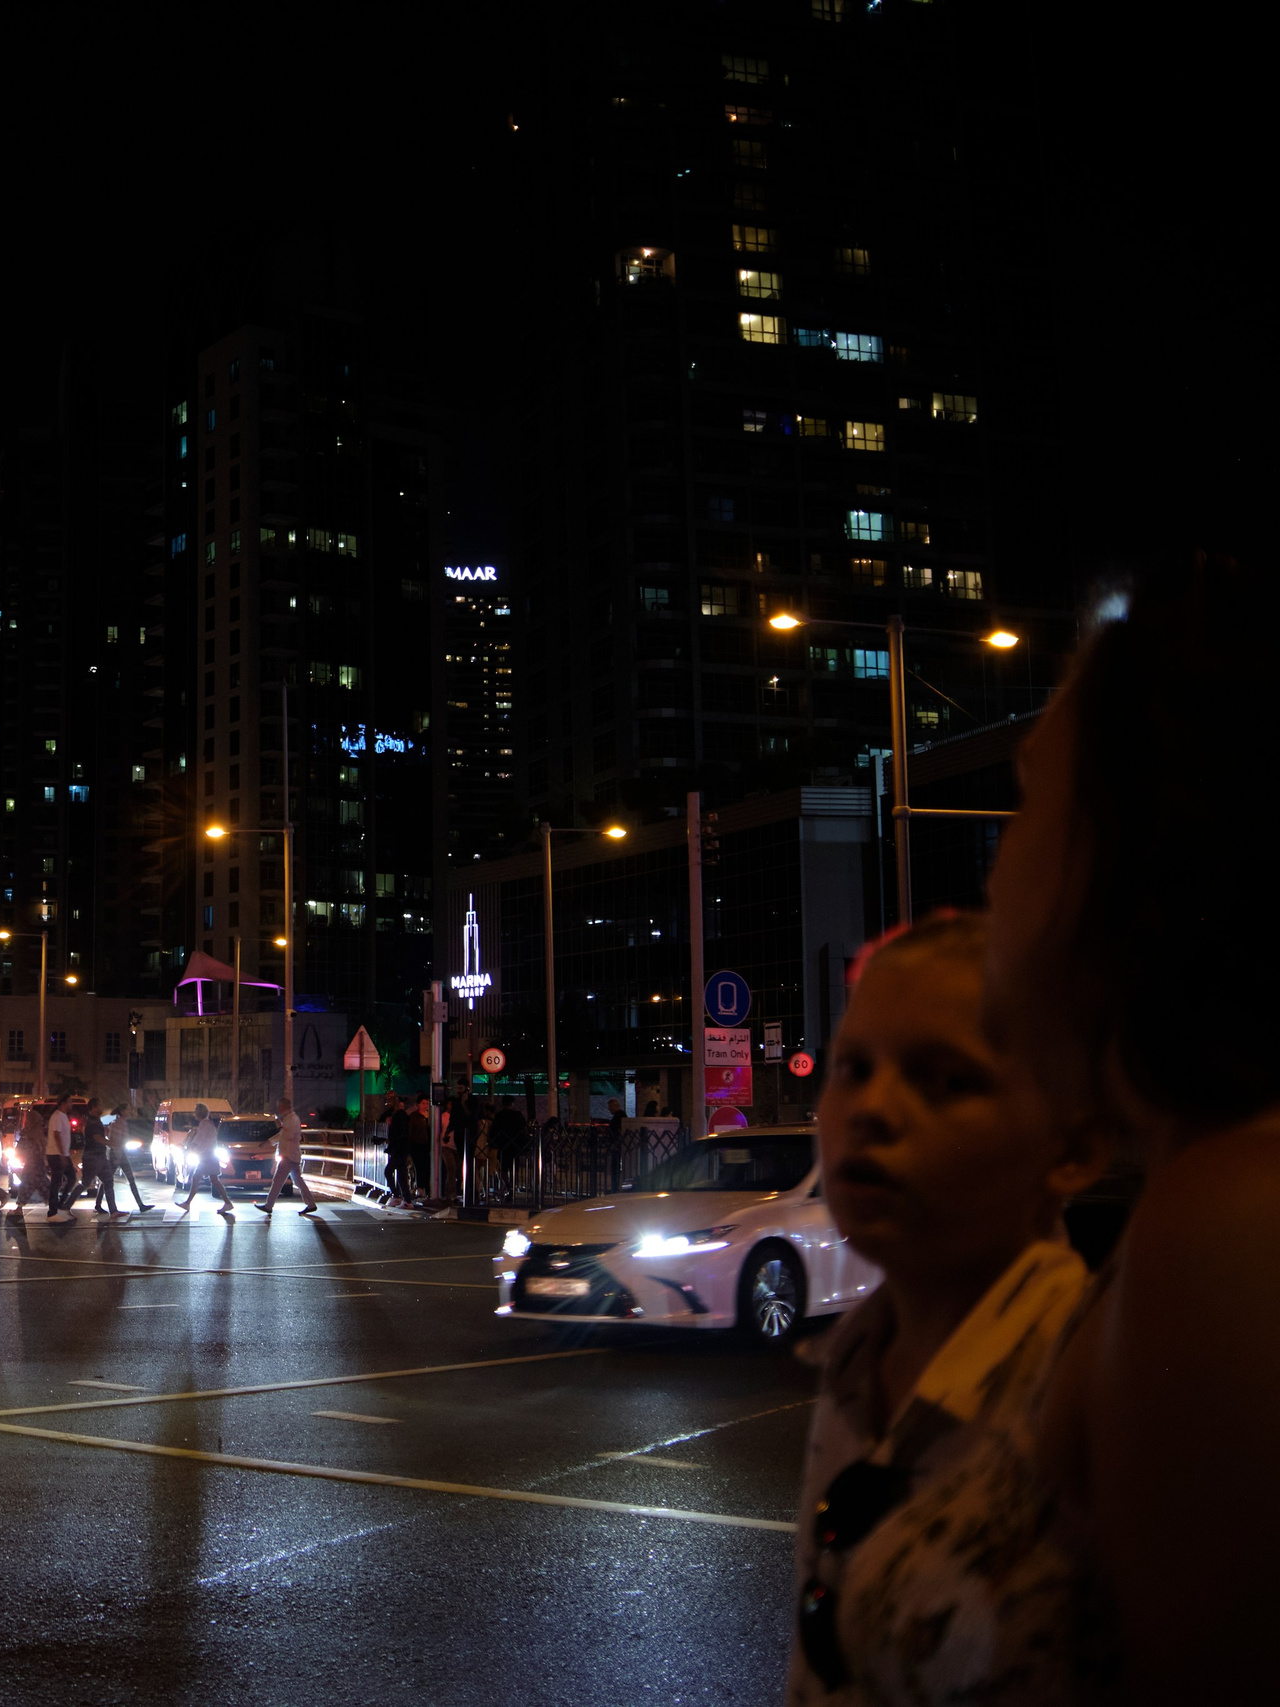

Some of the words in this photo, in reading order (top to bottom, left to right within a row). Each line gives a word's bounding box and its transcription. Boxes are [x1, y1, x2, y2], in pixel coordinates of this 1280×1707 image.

[445, 566, 497, 580] MAAR
[451, 973, 492, 989] MARINA
[707, 1049, 728, 1058] Tram
[730, 1050, 749, 1059] Only
[486, 1056, 500, 1065] 60
[794, 1060, 808, 1069] 60
